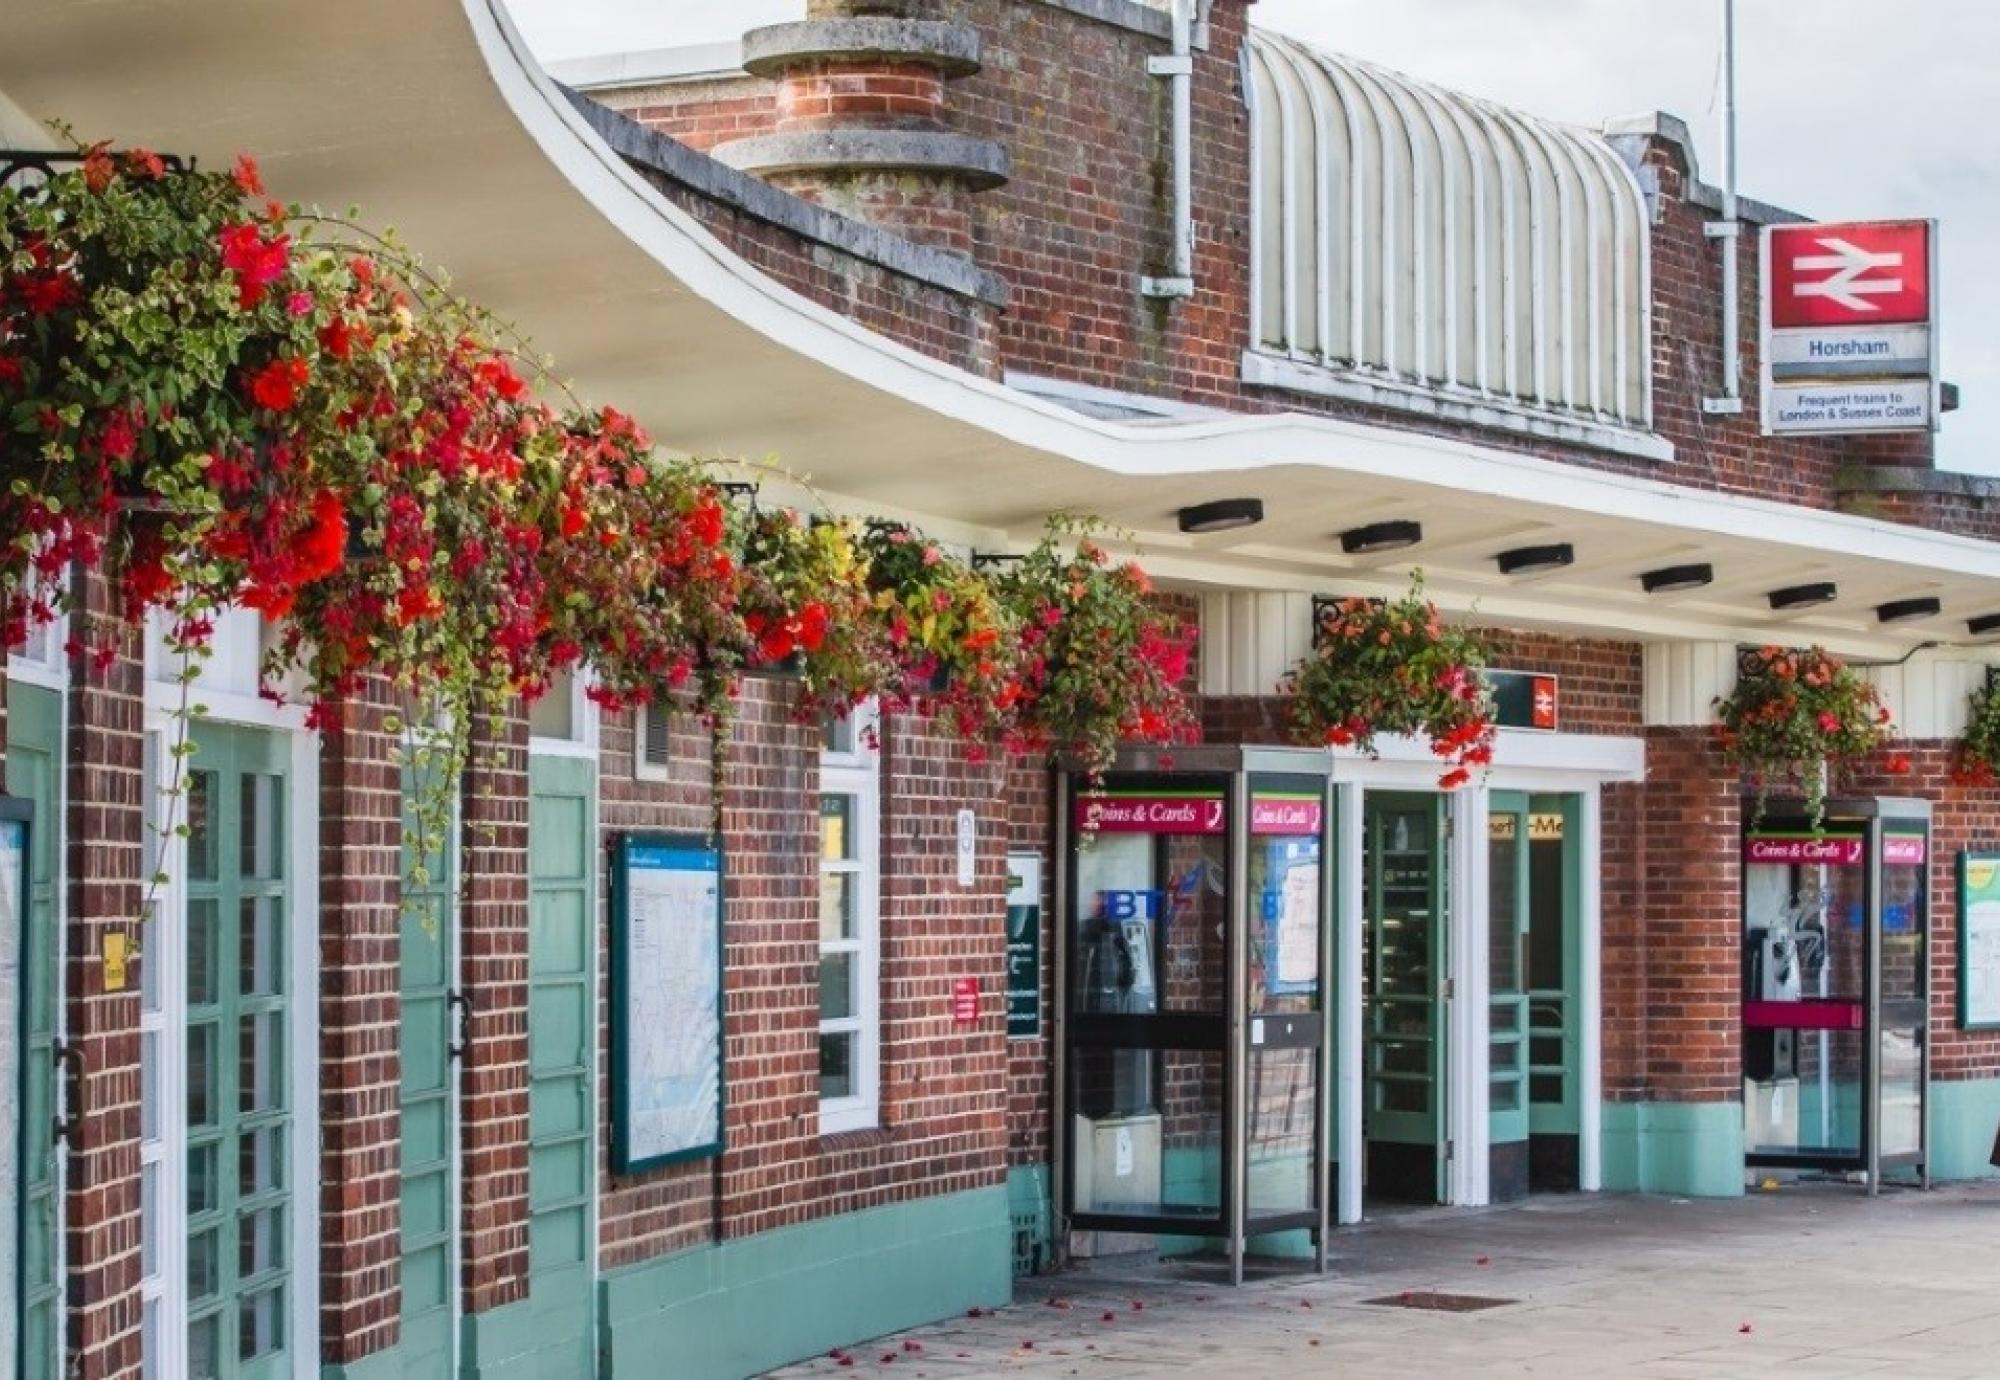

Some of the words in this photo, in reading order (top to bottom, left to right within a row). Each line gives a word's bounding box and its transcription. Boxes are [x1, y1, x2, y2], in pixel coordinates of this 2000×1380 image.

[1808, 339, 1889, 356] Horsham
[1798, 394, 1850, 406] Frequent
[1853, 394, 1887, 404] trains
[1889, 392, 1903, 403] to
[1779, 409, 1825, 421] London
[1828, 408, 1836, 419] &
[1838, 406, 1882, 419] Sussex
[1885, 404, 1921, 417] Coast
[1132, 803, 1147, 821] &
[1149, 802, 1197, 821] Cards
[1752, 841, 1788, 857] Coins
[1789, 842, 1800, 857] &
[1802, 841, 1840, 857] Cards
[1107, 890, 1162, 919] BT
